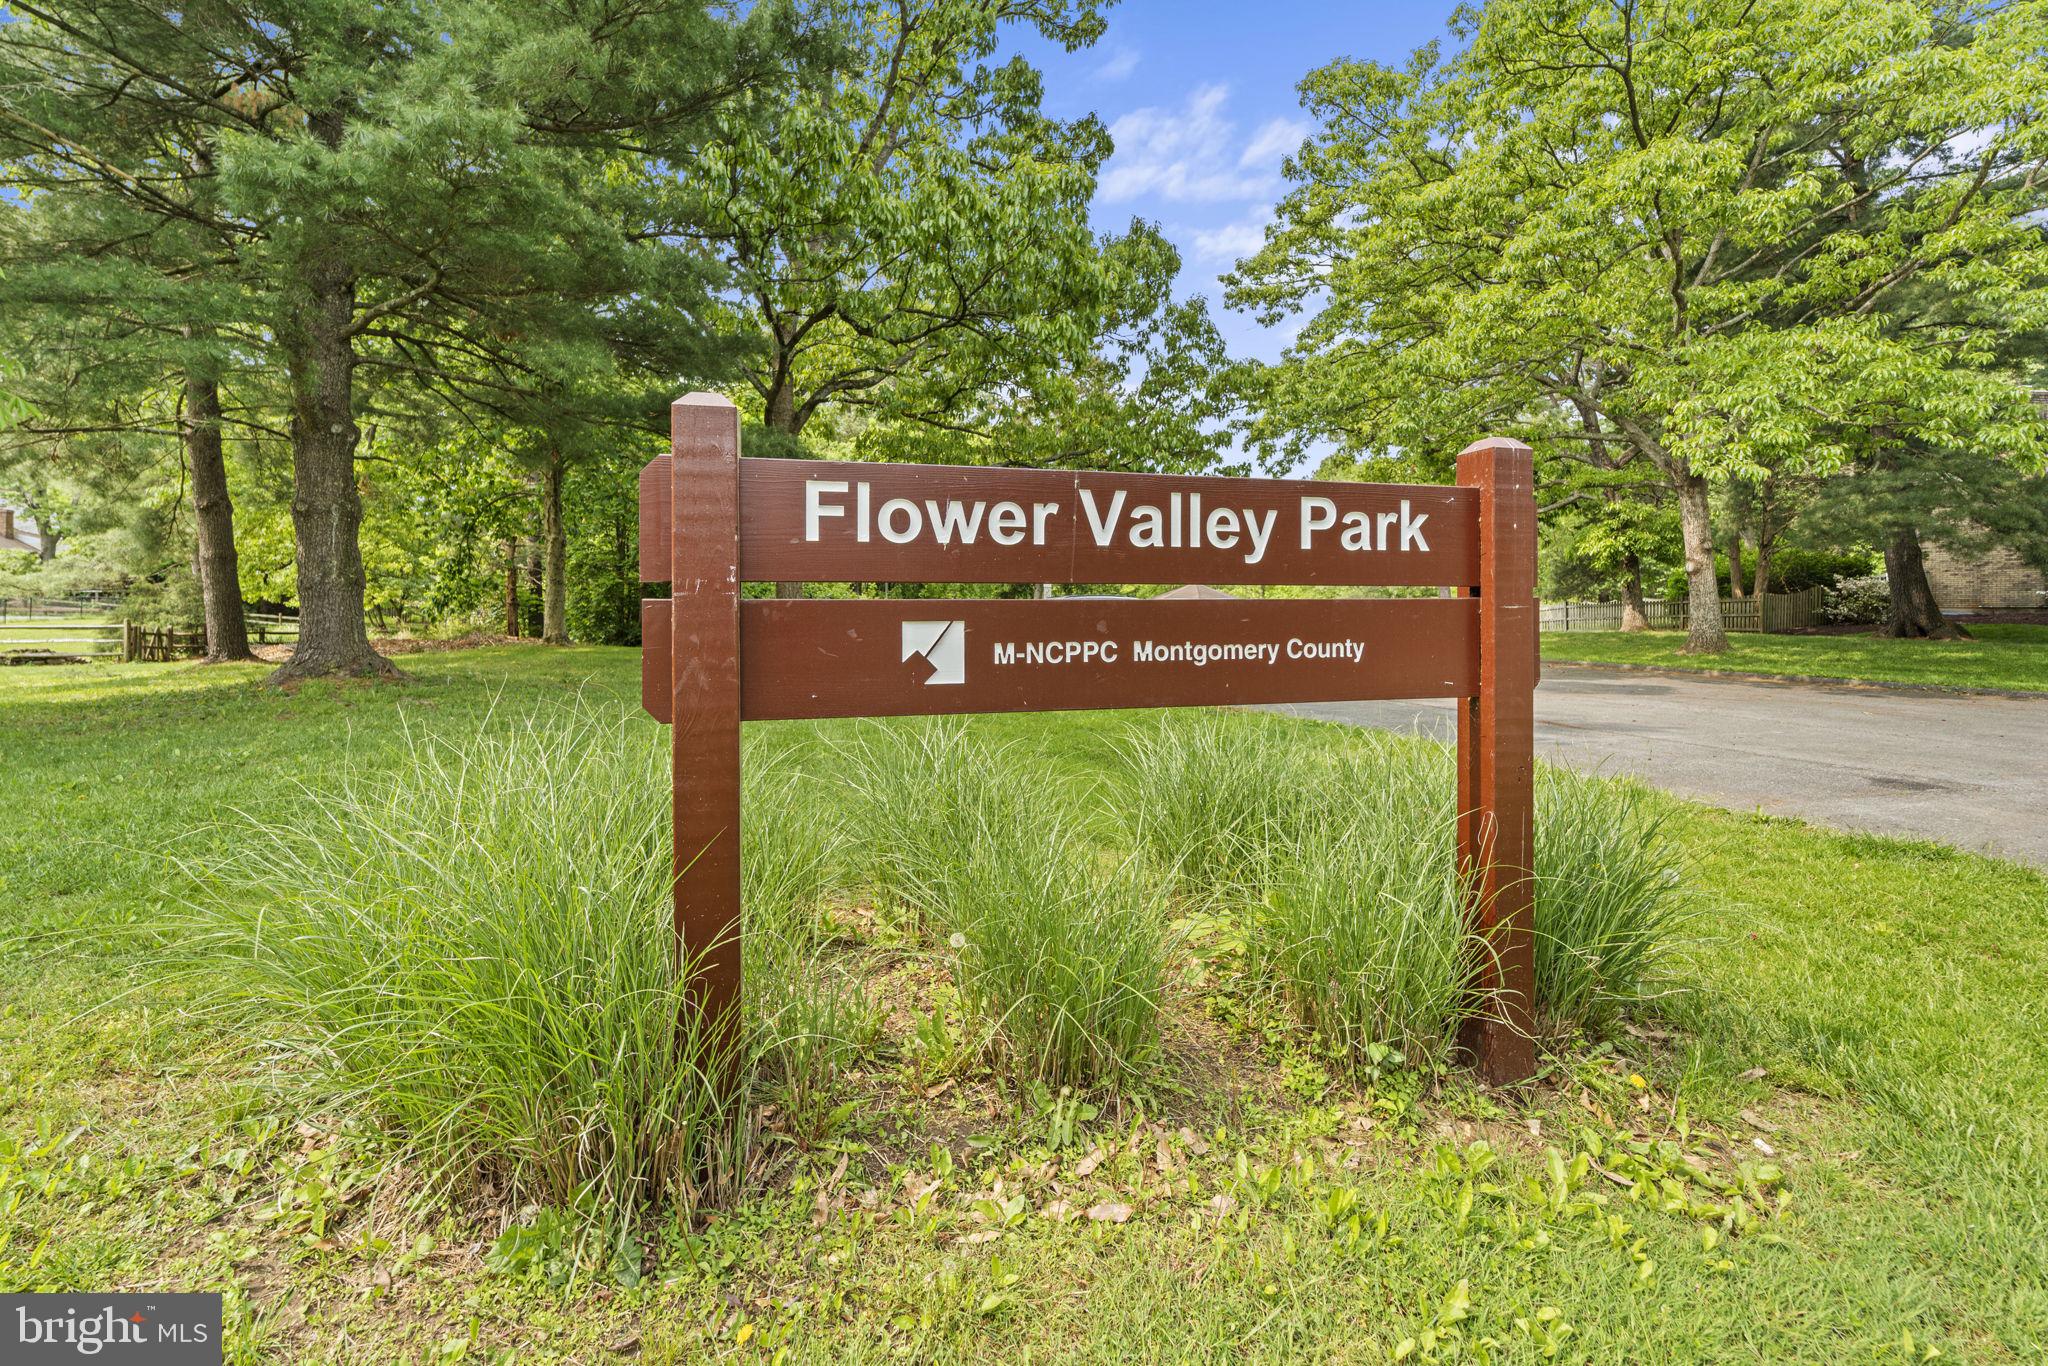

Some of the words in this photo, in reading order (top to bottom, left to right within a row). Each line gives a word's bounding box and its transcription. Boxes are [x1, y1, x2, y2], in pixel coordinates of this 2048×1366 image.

[805, 480, 1060, 546] Flower
[1079, 489, 1277, 564] Valley
[1301, 497, 1429, 551] Park
[995, 641, 1117, 664] M-NCPPC
[1134, 641, 1279, 666] Montgomery
[1287, 639, 1364, 662] County
